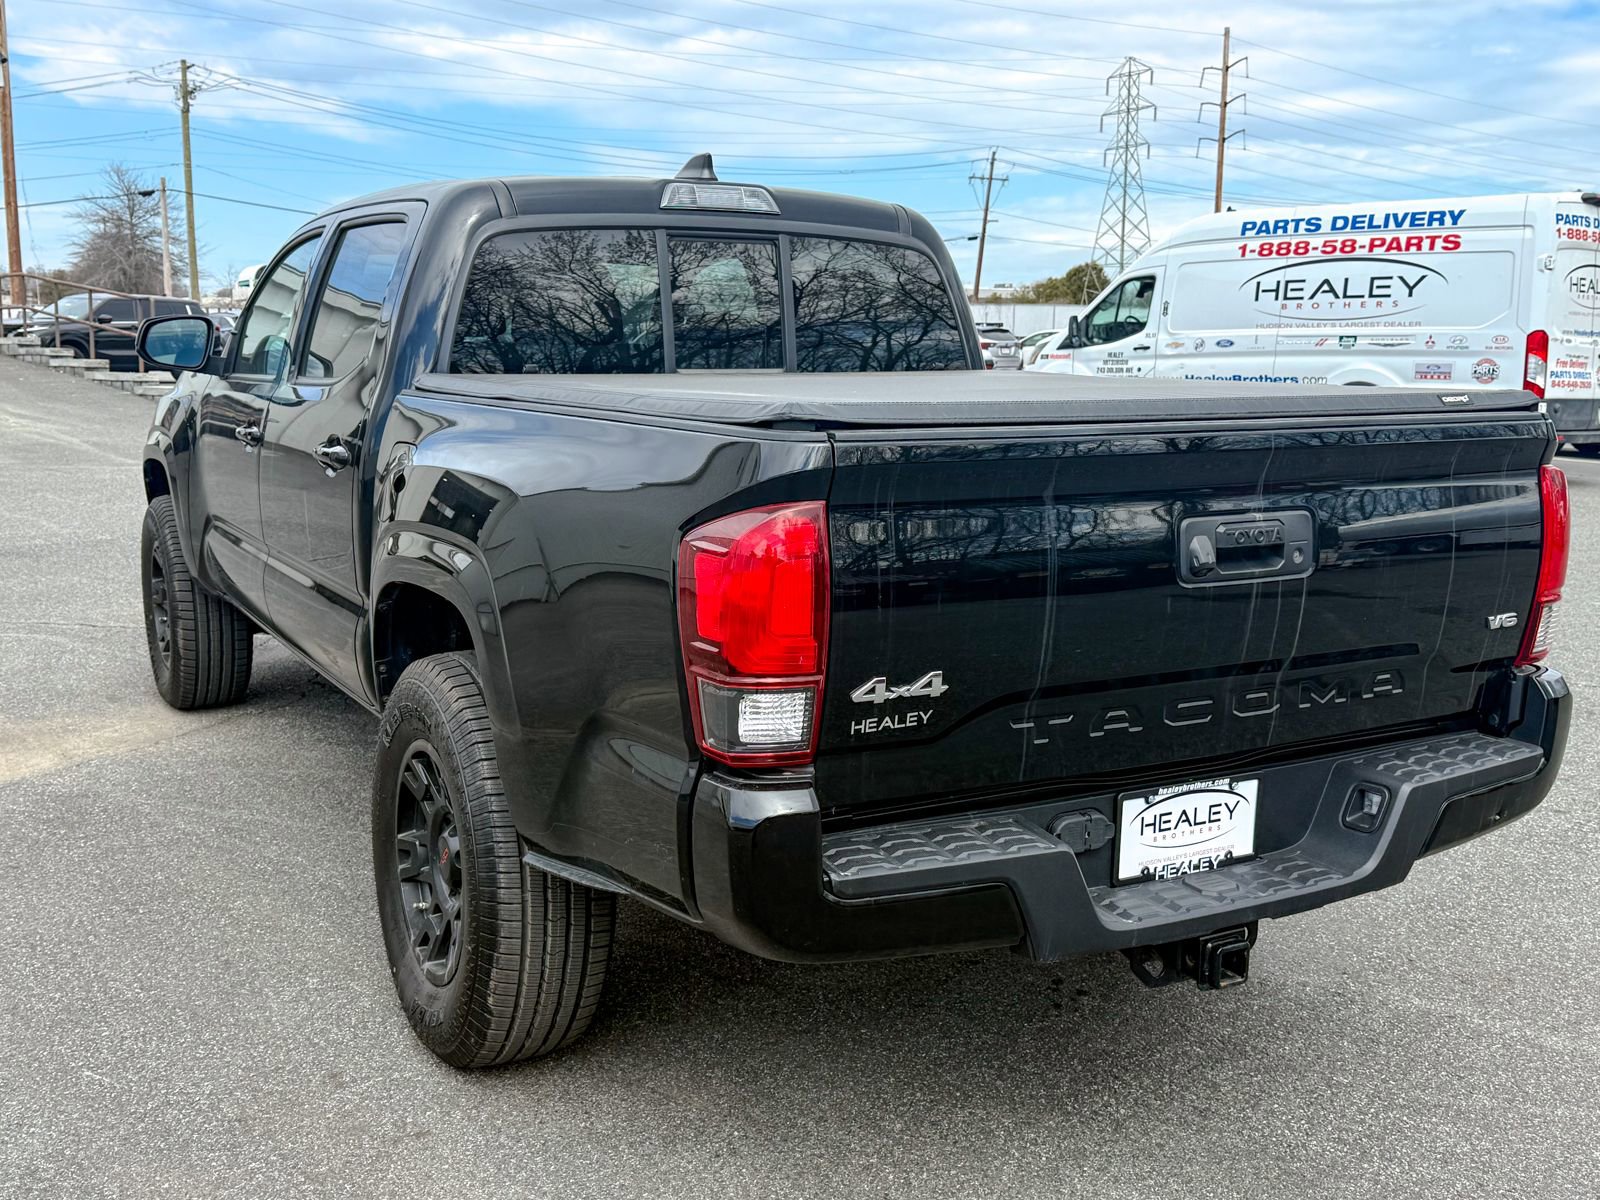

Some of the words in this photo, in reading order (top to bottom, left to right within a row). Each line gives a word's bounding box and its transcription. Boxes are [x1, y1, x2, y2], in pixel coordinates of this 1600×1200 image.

[1240, 216, 1322, 236] PARTS
[1330, 209, 1467, 232] DELIVERY
[1556, 213, 1591, 228] PARTS
[1238, 234, 1462, 258] 1-888-58-PARTS
[1254, 275, 1429, 302] HEALEY
[1281, 300, 1400, 310] BROTHERS
[1256, 321, 1293, 329] HUDSON
[1383, 320, 1422, 328] DEALER
[1472, 364, 1499, 375] PARTS
[1550, 371, 1572, 379] PARTS
[1225, 527, 1283, 545] TOYOTA
[1488, 612, 1518, 630] V6
[1009, 669, 1406, 745] TACOMA
[851, 709, 934, 735] HEALEY
[1158, 777, 1231, 796] healeybrothers.com
[1140, 800, 1241, 836] HEALEY
[1153, 824, 1222, 843] BROTHERS
[1138, 858, 1162, 867] HUDSON
[1163, 852, 1188, 864] VALLEY'S
[1189, 848, 1213, 858] LARGEST
[1214, 844, 1235, 853] DEALER
[1155, 855, 1221, 881] HEALEY
